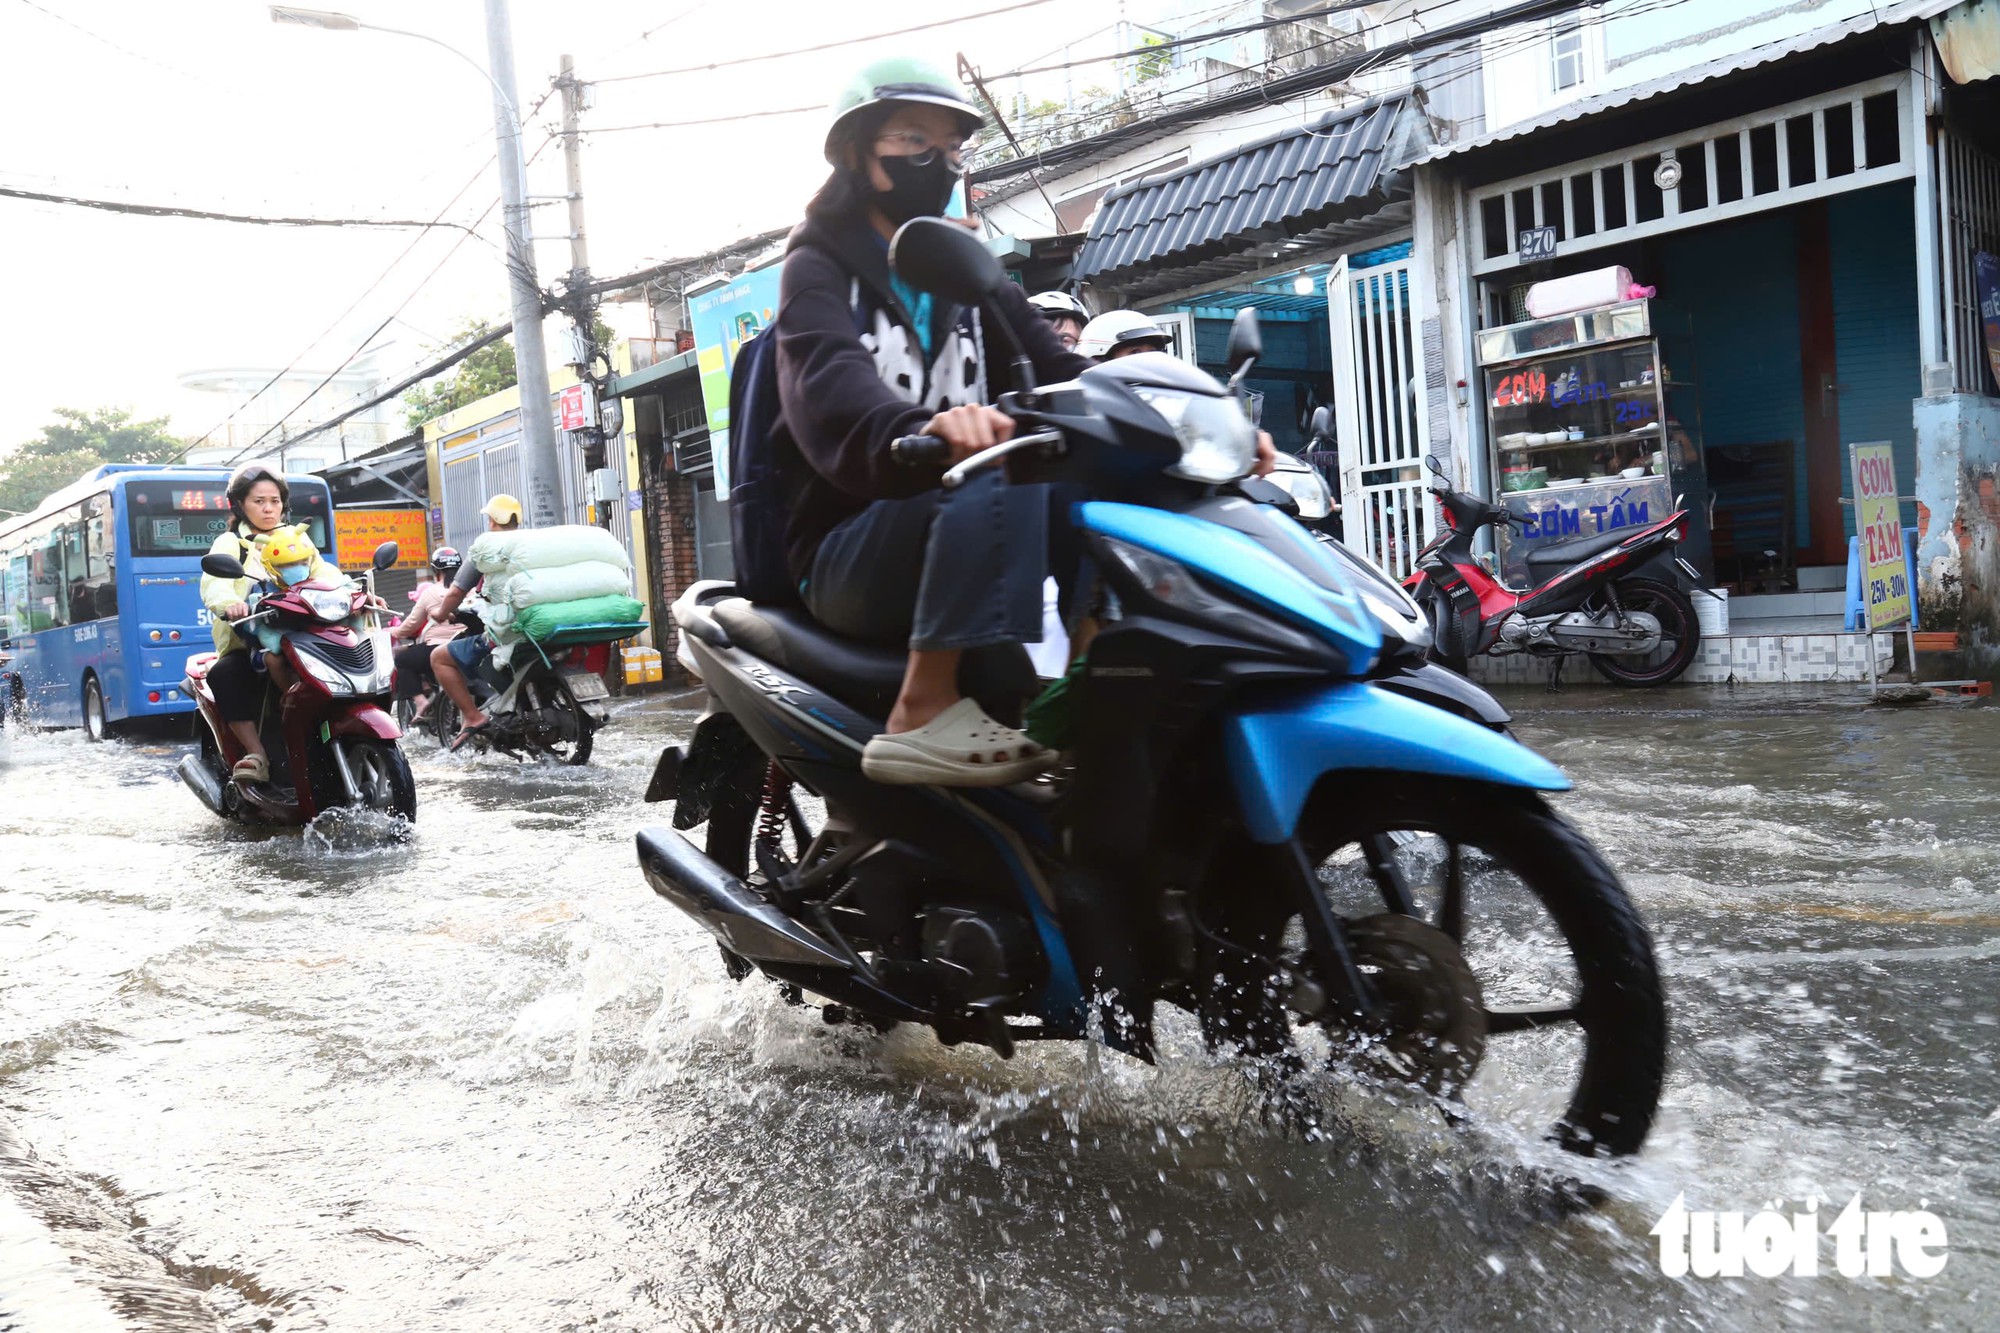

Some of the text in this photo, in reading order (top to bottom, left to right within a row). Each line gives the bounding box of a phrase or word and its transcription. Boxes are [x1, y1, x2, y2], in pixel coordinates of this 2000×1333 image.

[1522, 229, 1555, 255] 270
[1496, 371, 1546, 406] CƠM
[1859, 450, 1894, 496] CƠM
[181, 490, 206, 510] 44
[1523, 487, 1649, 539] CƠM TẤM
[393, 512, 424, 525] 278
[1866, 506, 1902, 564] TẤM
[1450, 586, 1470, 599] YAMAHA
